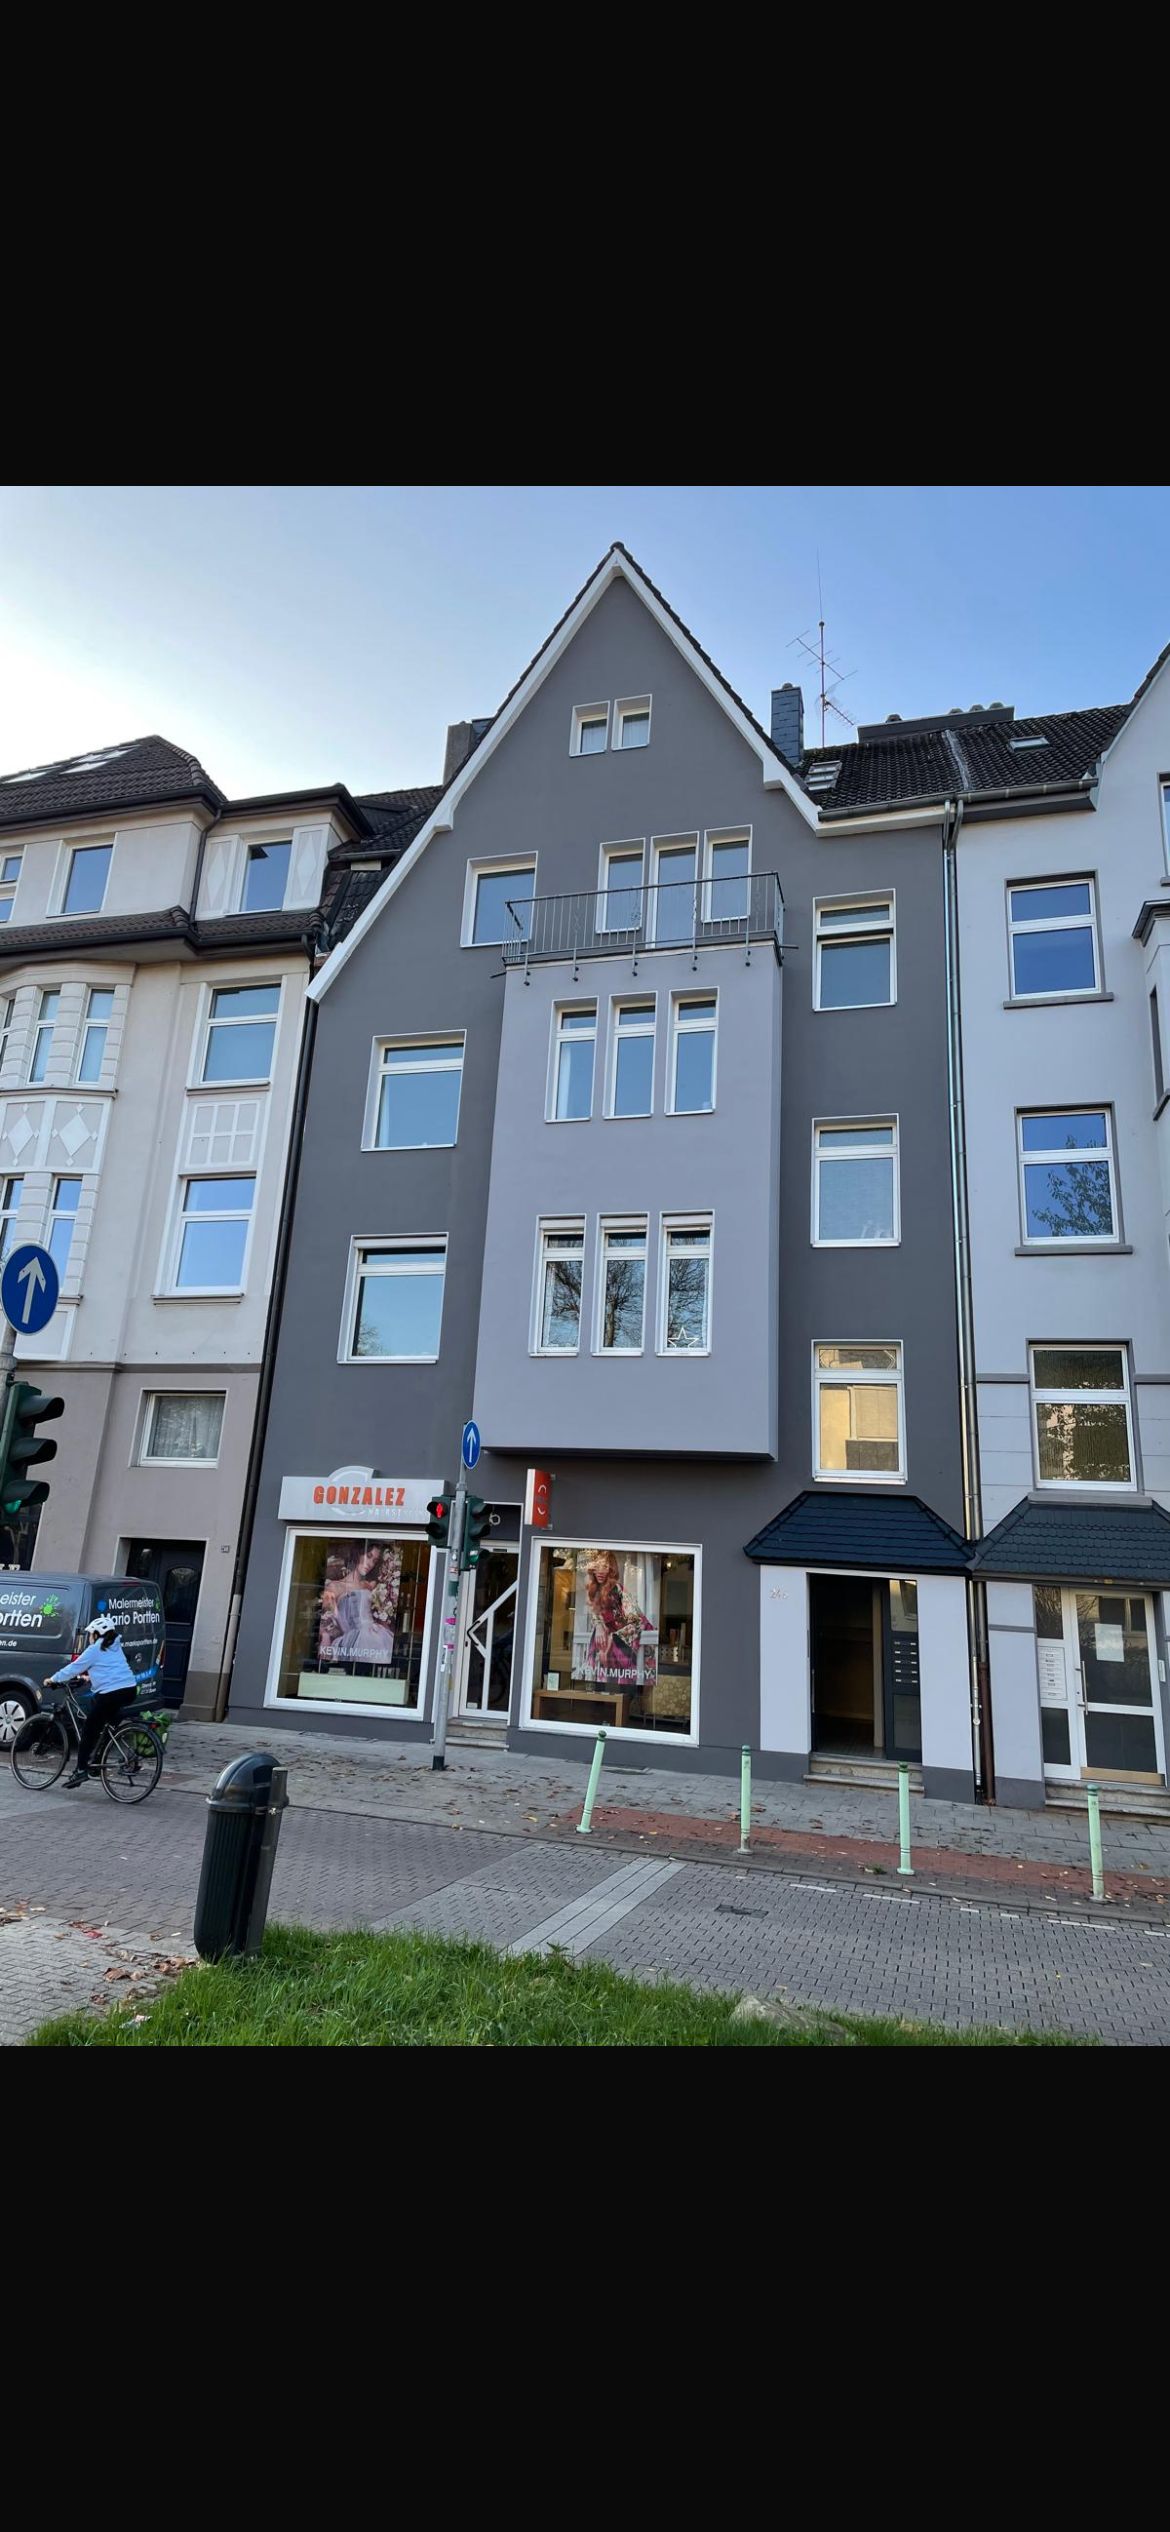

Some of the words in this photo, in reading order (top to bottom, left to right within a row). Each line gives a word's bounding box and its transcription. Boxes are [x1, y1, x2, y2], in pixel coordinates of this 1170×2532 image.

[313, 1485, 405, 1506] GONZALEZ
[108, 1597, 154, 1610] Malermeister
[132, 1610, 160, 1625] Portten
[320, 1645, 389, 1659] KEVIN.MURPHY
